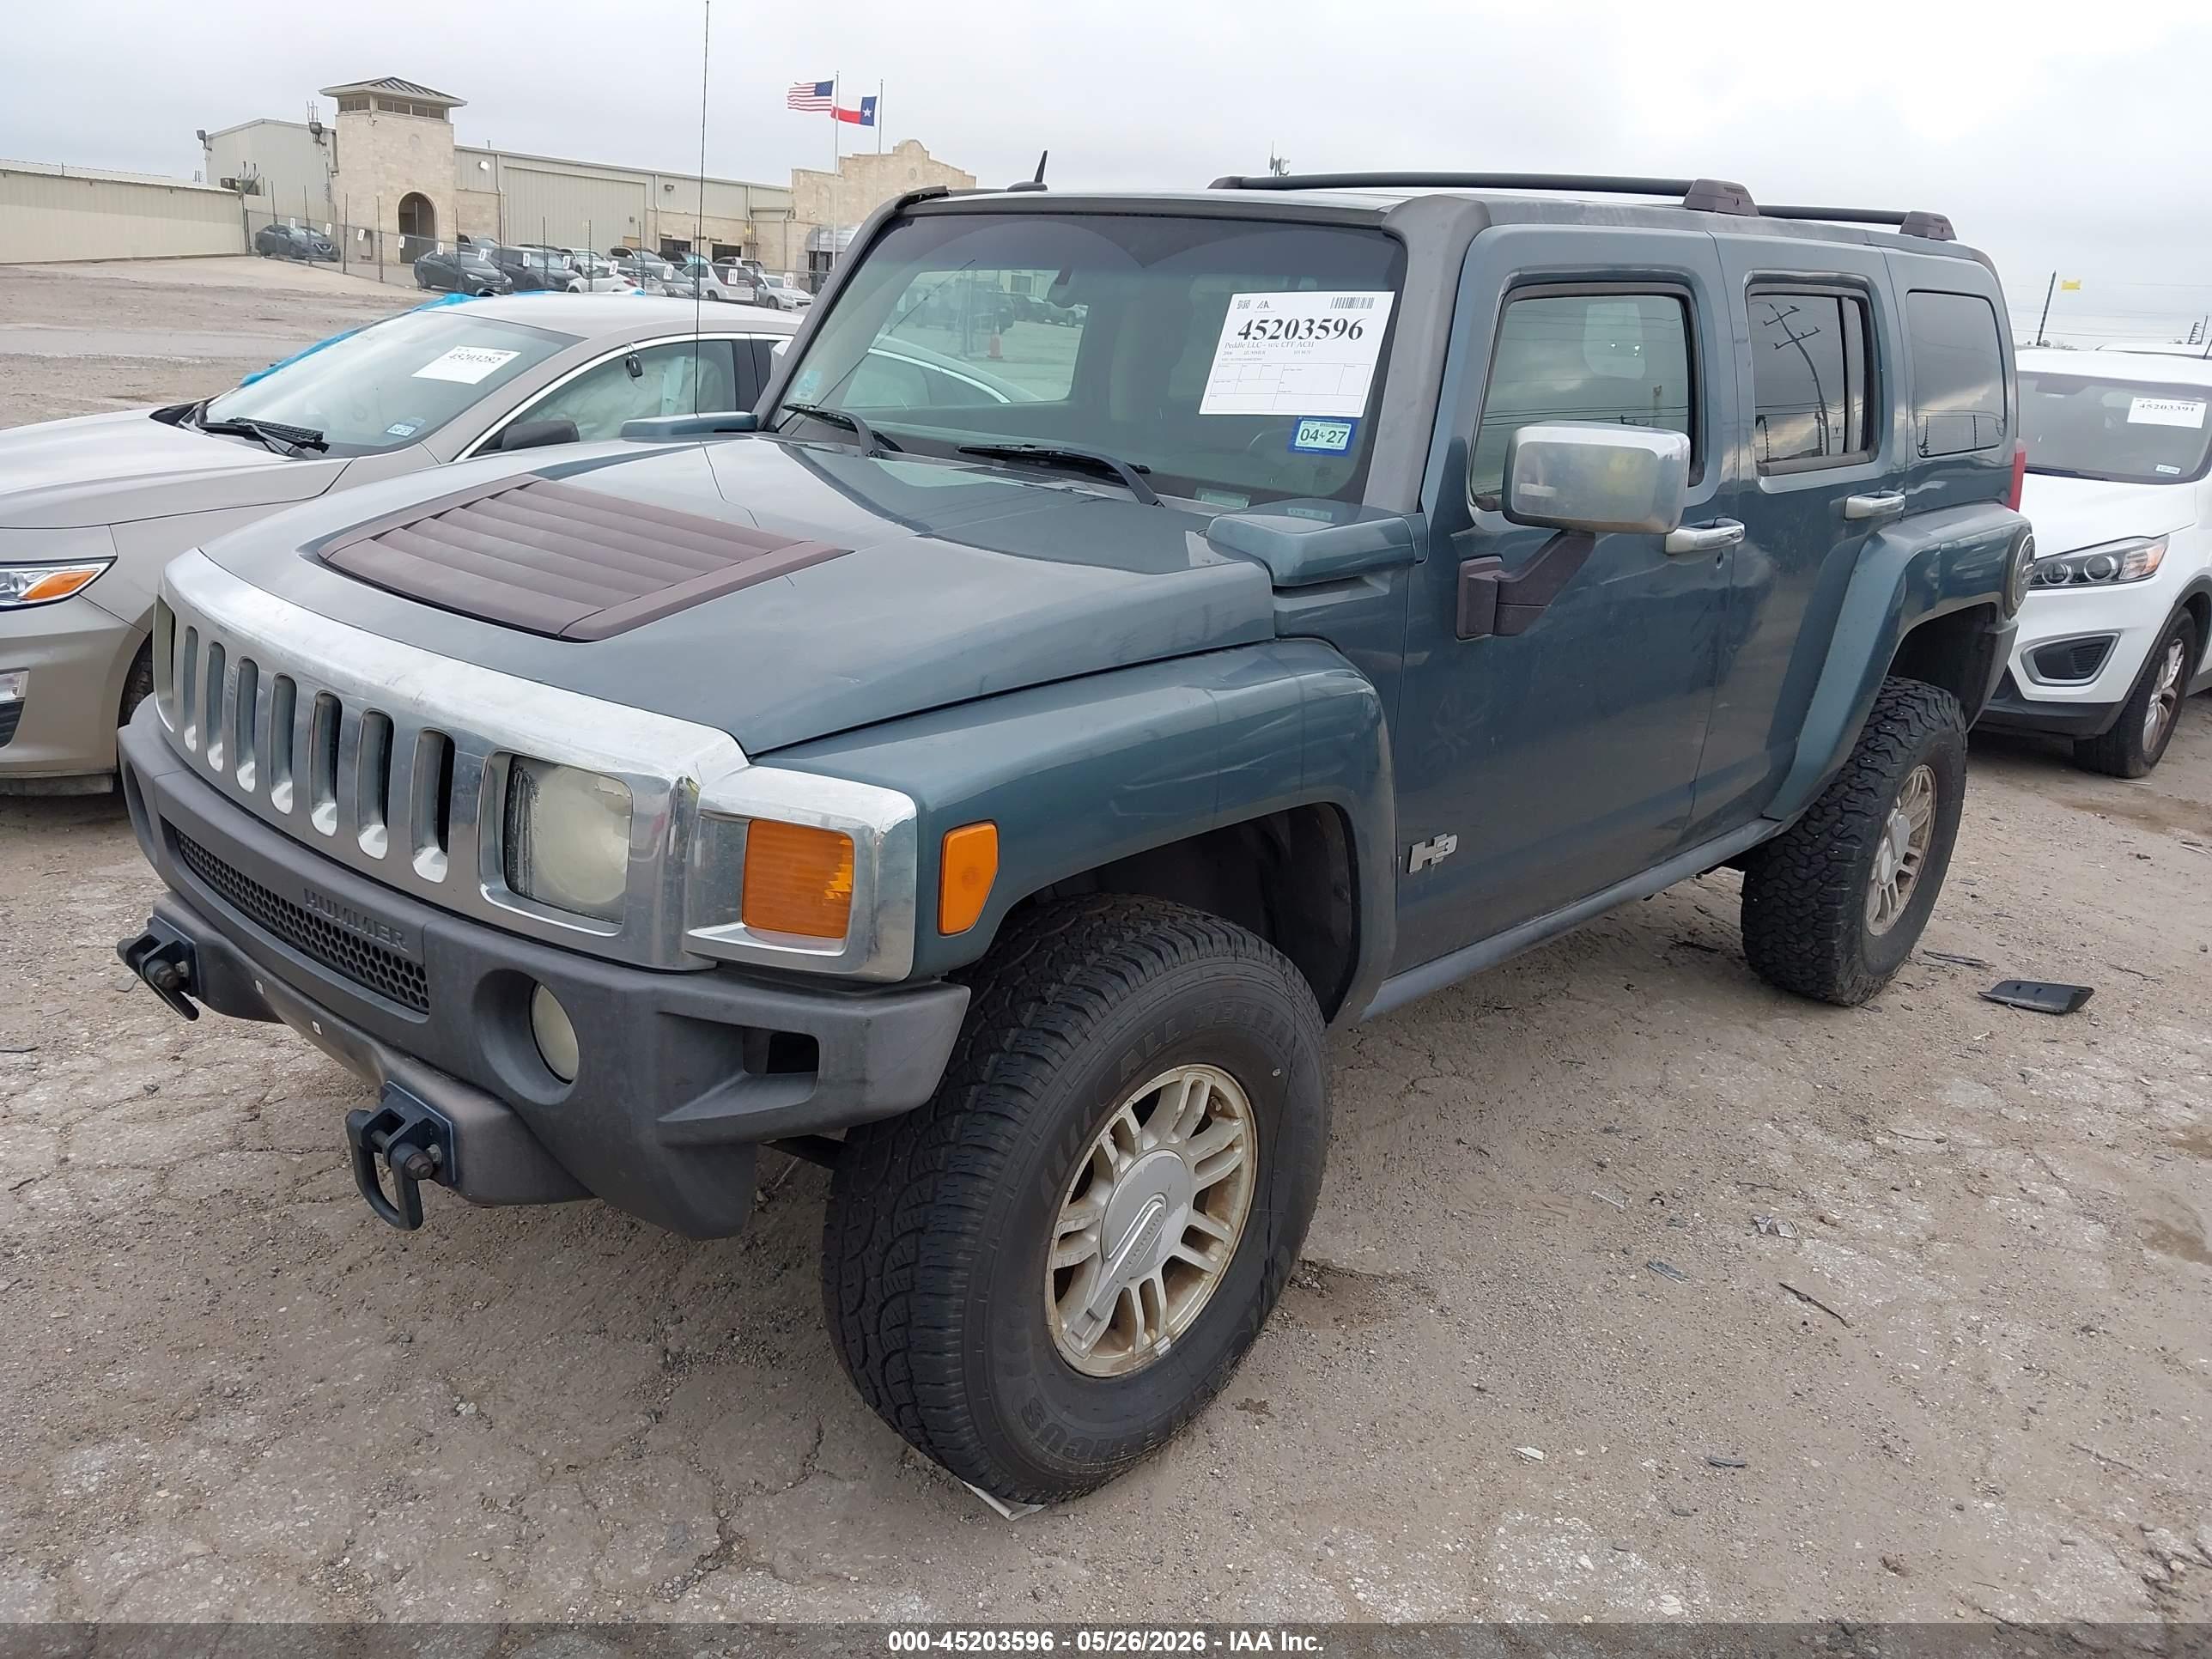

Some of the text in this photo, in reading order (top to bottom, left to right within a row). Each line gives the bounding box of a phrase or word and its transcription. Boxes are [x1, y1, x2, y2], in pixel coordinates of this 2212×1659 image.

[1237, 318, 1368, 341] 45203596
[1408, 832, 1458, 873] H3
[303, 887, 409, 953] HUMMER
